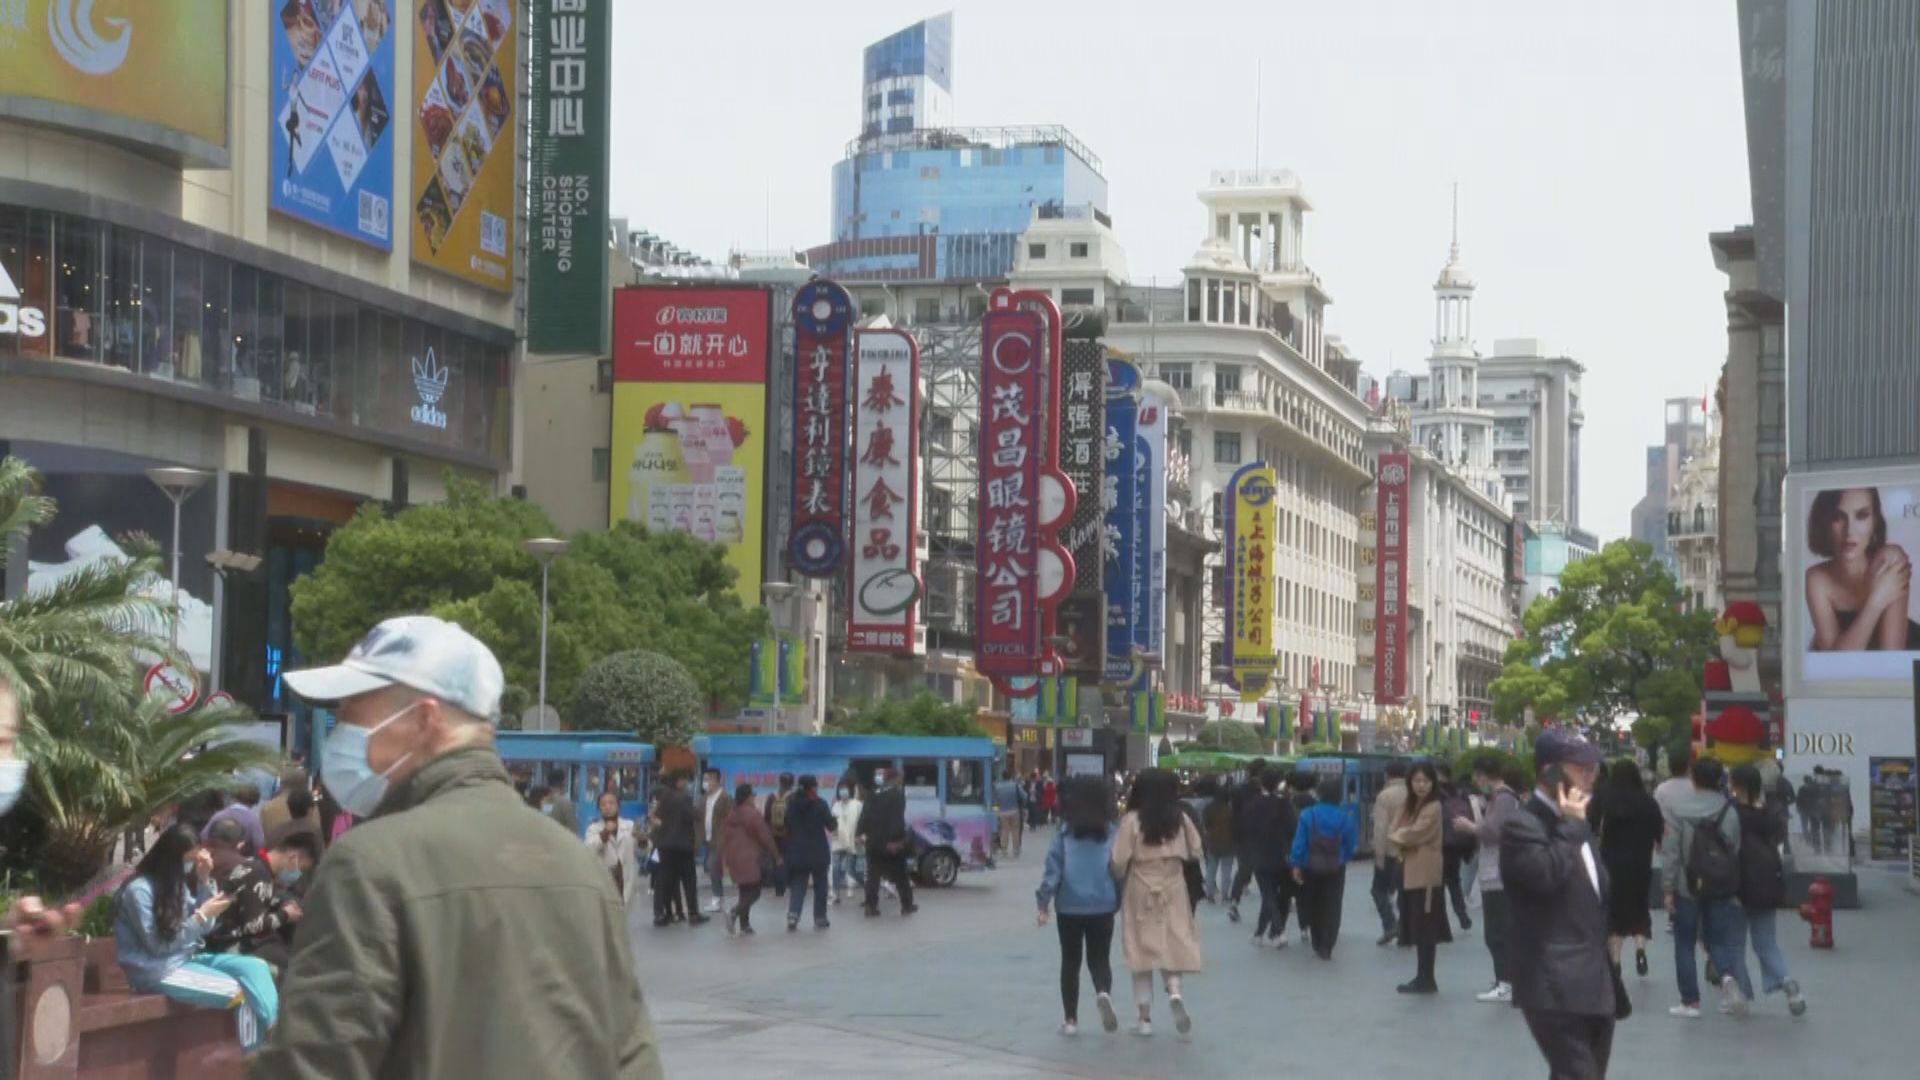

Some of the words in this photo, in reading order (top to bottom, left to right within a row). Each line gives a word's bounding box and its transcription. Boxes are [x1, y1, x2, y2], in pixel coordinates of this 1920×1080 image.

[549, 0, 587, 136] 业中心
[542, 175, 557, 252] CENTER
[557, 174, 573, 273] SHOPPING
[575, 174, 589, 216] NO.1
[411, 403, 447, 430] adidas
[861, 364, 906, 560] 泰康食品
[985, 381, 1031, 630] 茂昌眼镜公司
[1793, 732, 1855, 756] DIOR
